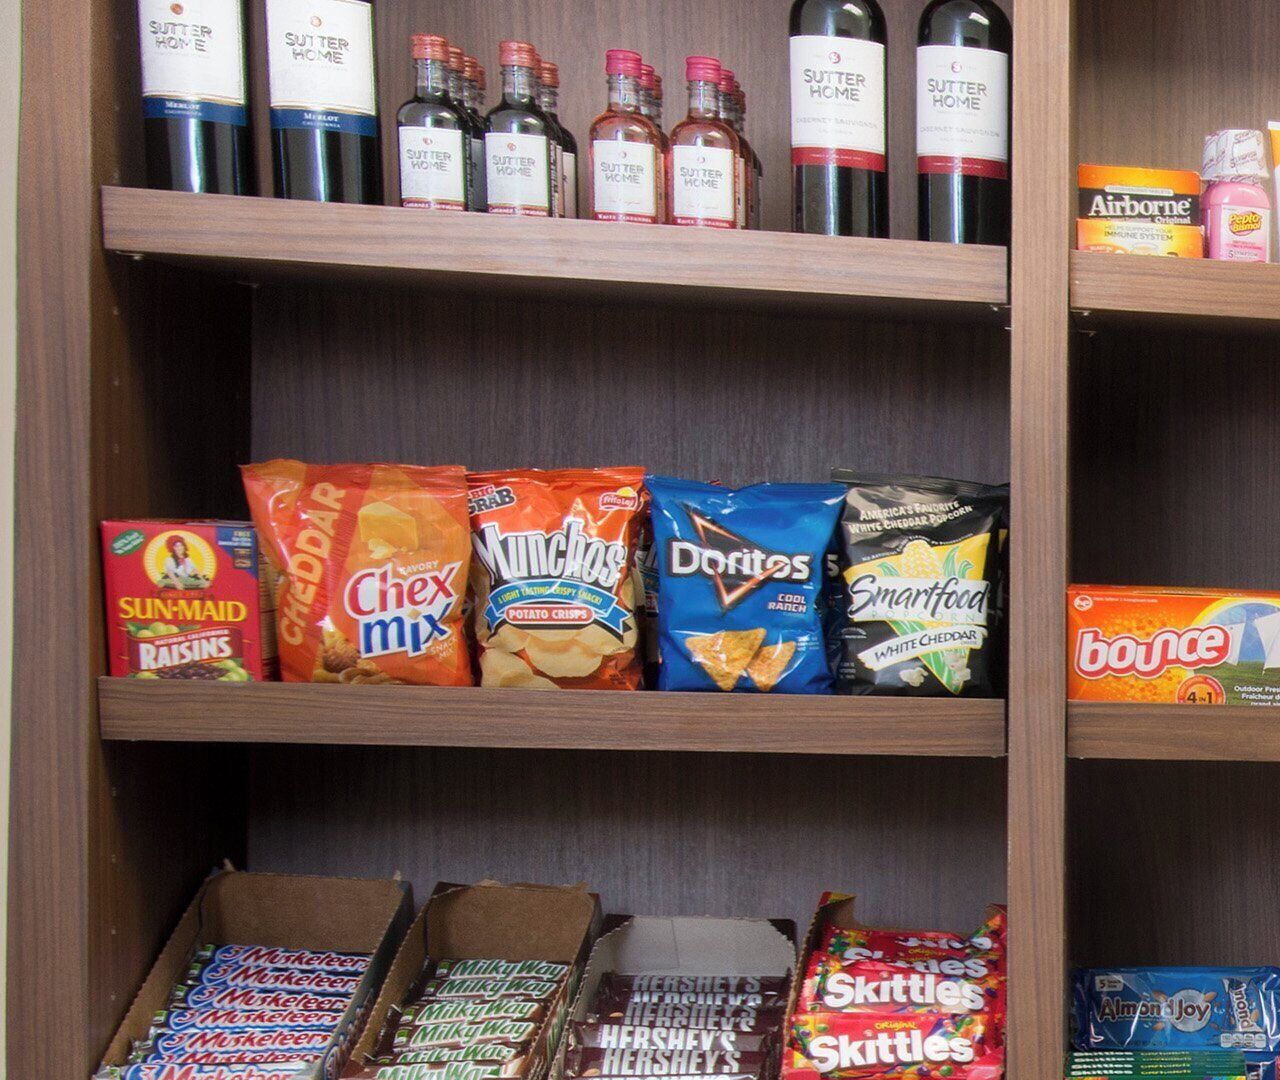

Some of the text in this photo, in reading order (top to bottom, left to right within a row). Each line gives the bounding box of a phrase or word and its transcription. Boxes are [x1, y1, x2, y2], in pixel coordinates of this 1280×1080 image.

[285, 32, 350, 51] SUTTER
[292, 47, 345, 65] HOME
[803, 68, 867, 87] SUTTER
[927, 78, 989, 97] SUTTER
[810, 85, 861, 102] HOME
[933, 95, 982, 111] HOME
[1088, 195, 1191, 217] Airborne
[850, 503, 975, 535] WHITE CHEDDAR POPCORN
[859, 500, 961, 522] AMERICA'S FAVORITE
[279, 482, 348, 646] CHEDDAR
[473, 518, 628, 592] Munchos
[671, 540, 813, 582] Doritos
[347, 561, 457, 619] Chex
[778, 592, 807, 604] COOL
[848, 574, 990, 619] Smartfood
[118, 596, 248, 622] SUN-MAID
[508, 607, 588, 620] POTATO CRISPS
[767, 601, 808, 614] RANCH
[363, 602, 451, 658] mix
[139, 636, 233, 671] RAISINS
[874, 625, 978, 662] WHITE CHEDDAR
[1079, 625, 1227, 670] bounce
[823, 972, 985, 1011] Skittles
[1099, 996, 1213, 1022] Almond Joy
[602, 1049, 742, 1076] HERSHEY'S
[809, 1029, 974, 1073] Skittles
